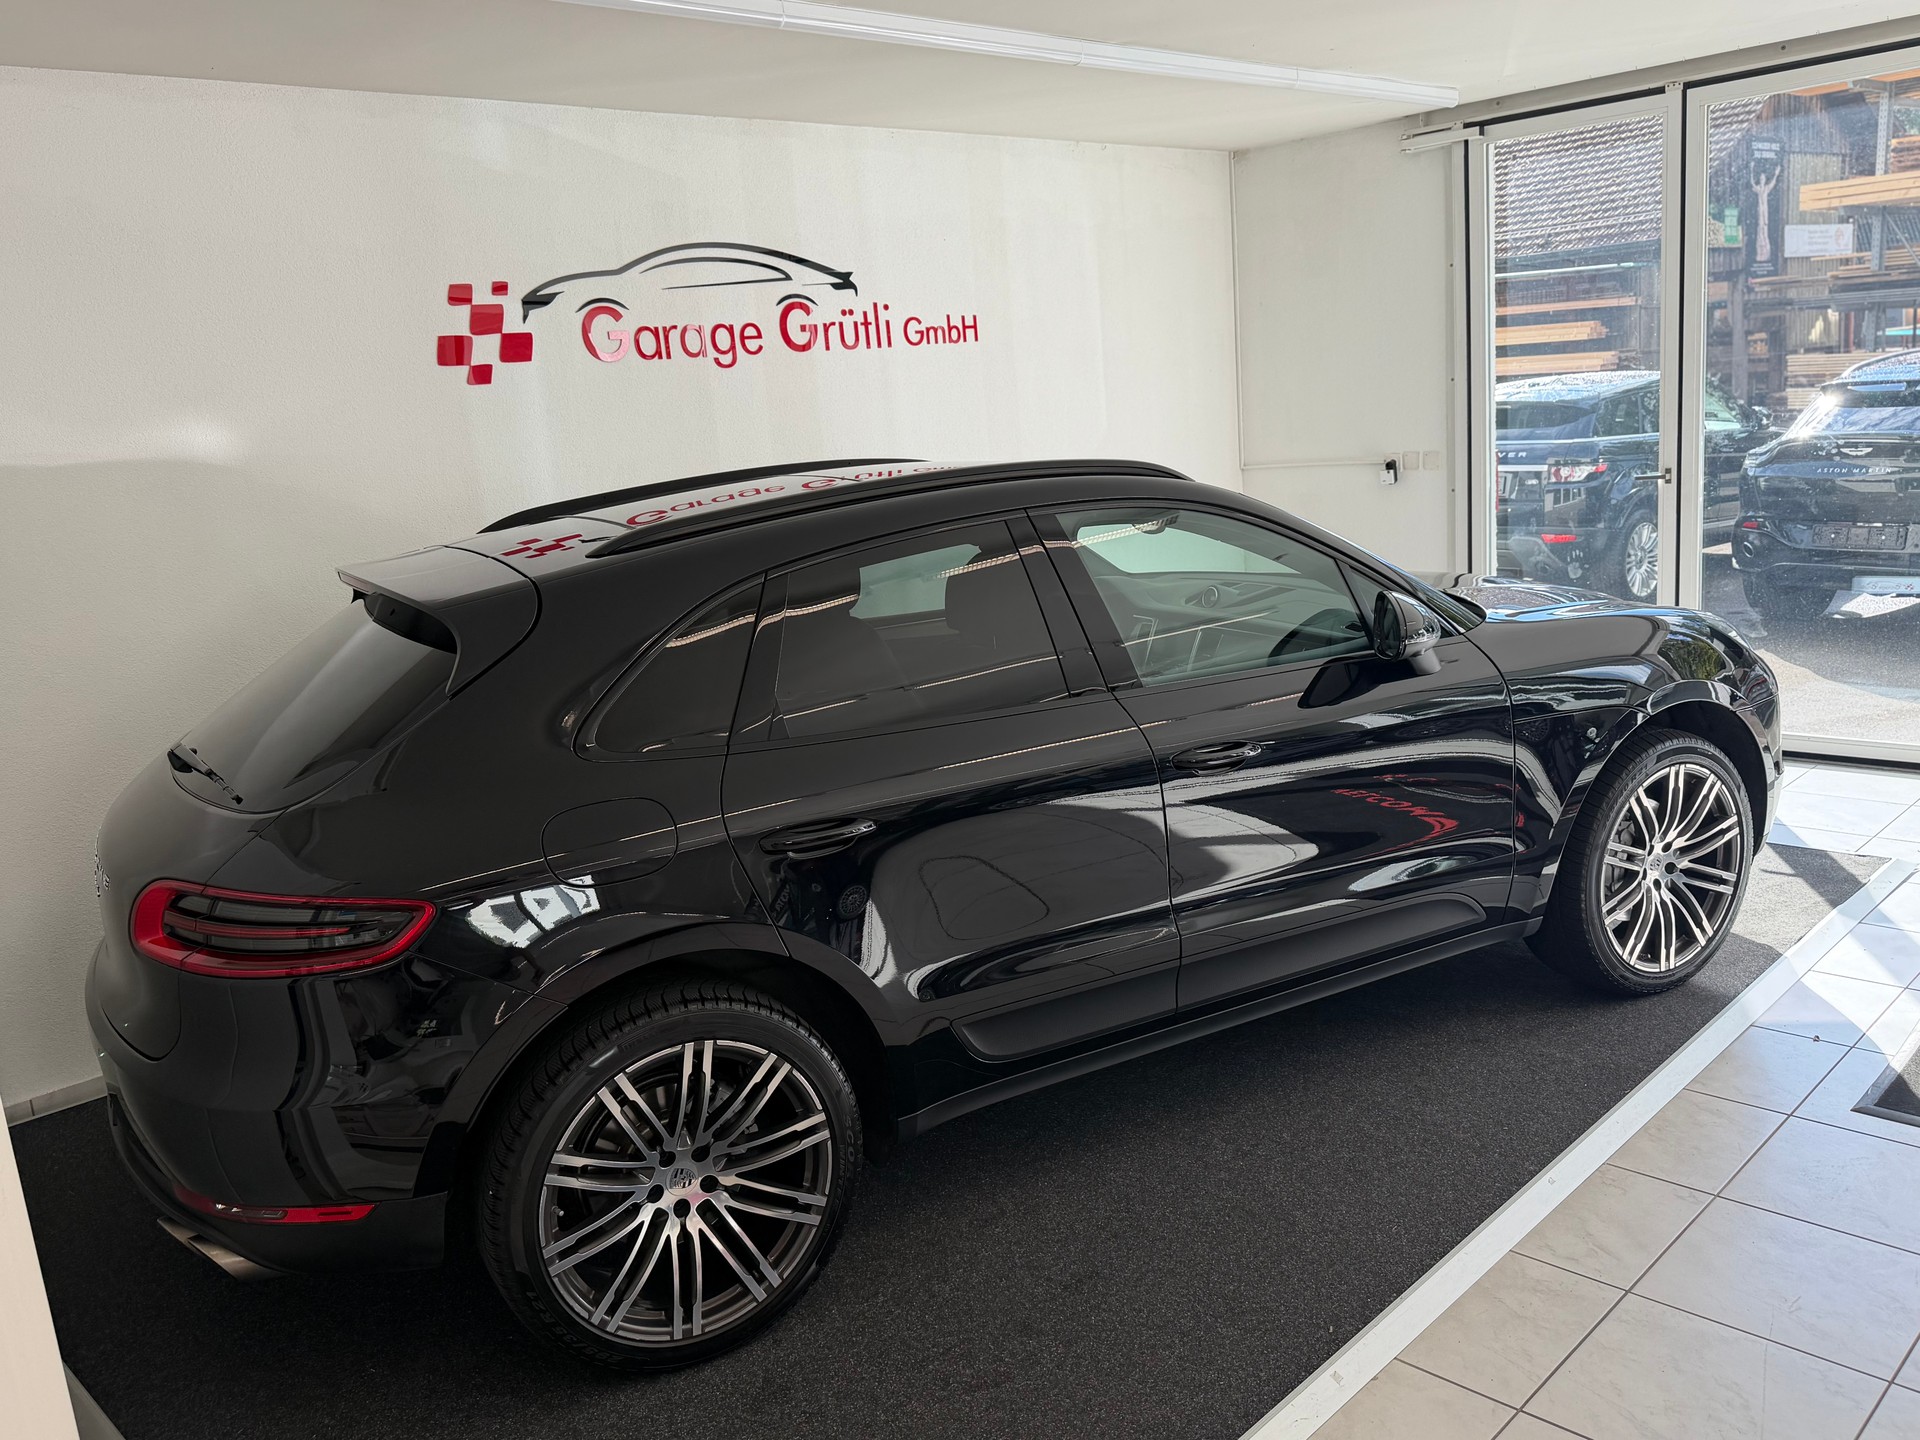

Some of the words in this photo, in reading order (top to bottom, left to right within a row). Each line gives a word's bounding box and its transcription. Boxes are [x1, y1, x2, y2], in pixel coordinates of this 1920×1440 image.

[582, 305, 763, 369] Garage
[779, 300, 892, 353] Grütli
[903, 314, 979, 346] GmbH
